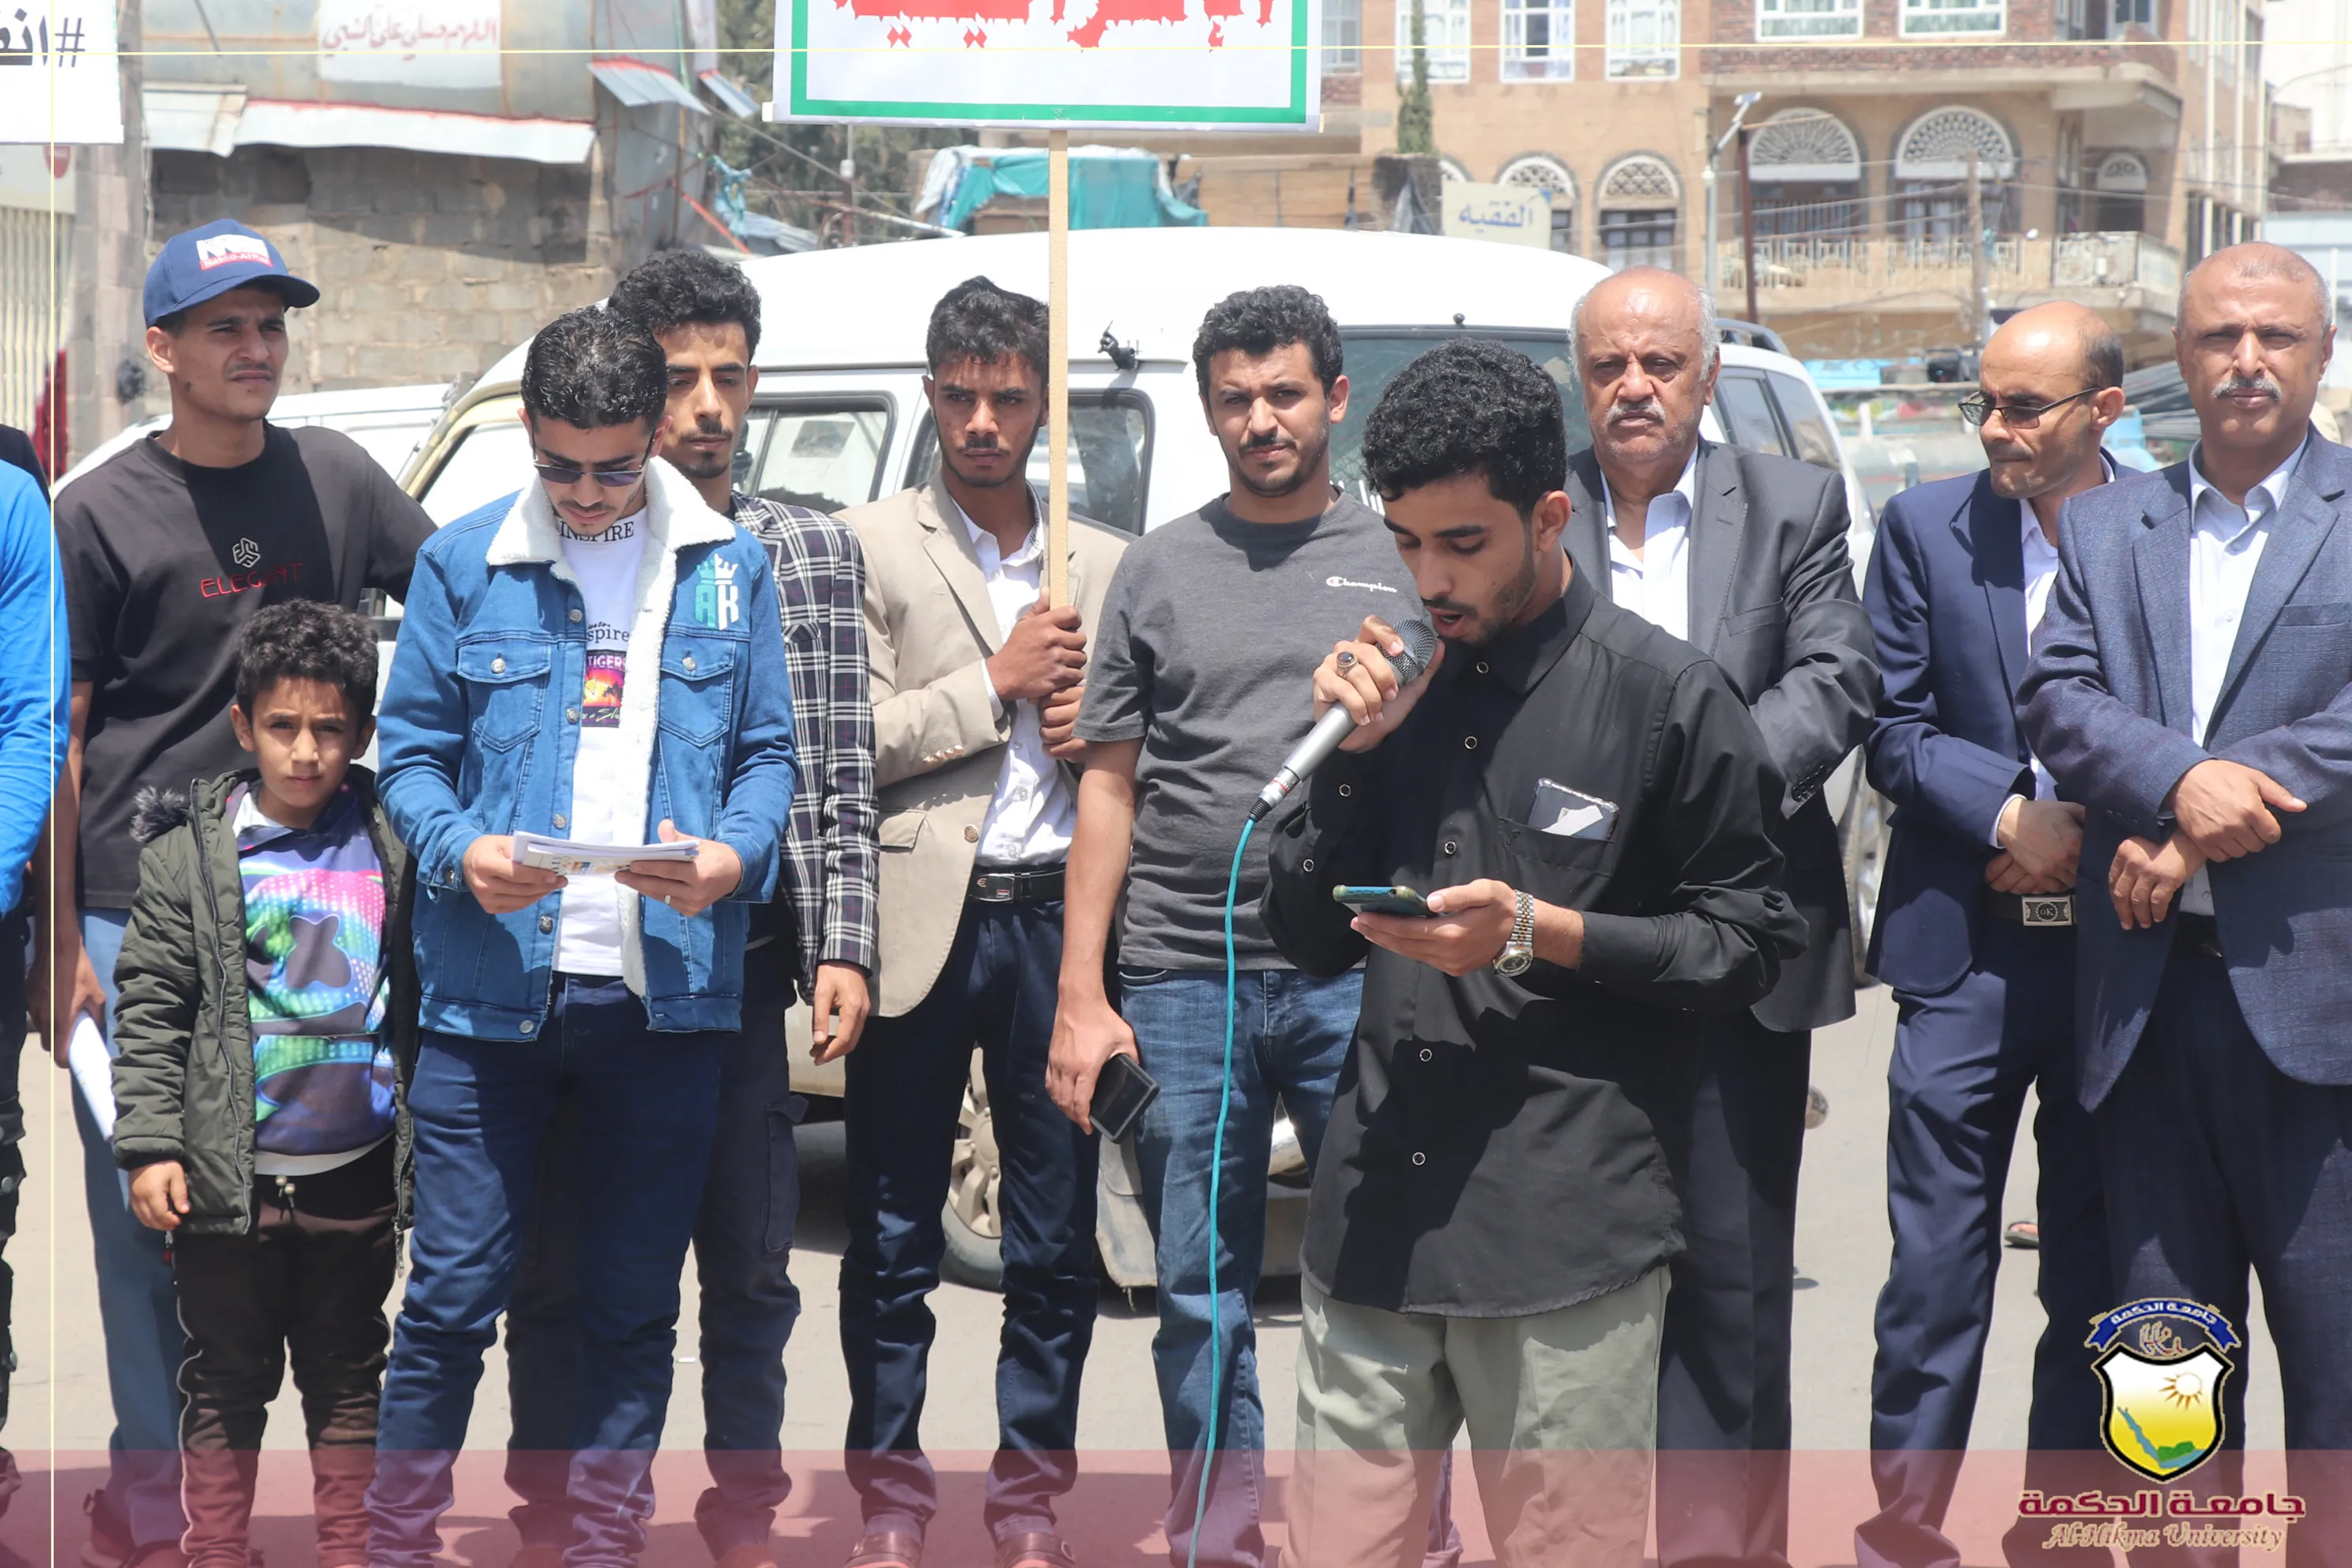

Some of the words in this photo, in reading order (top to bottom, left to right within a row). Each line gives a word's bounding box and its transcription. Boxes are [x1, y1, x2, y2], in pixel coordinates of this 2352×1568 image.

[1459, 201, 1533, 233] الفقيه
[201, 563, 303, 598] ELEGANT
[1326, 576, 1397, 593] Champion
